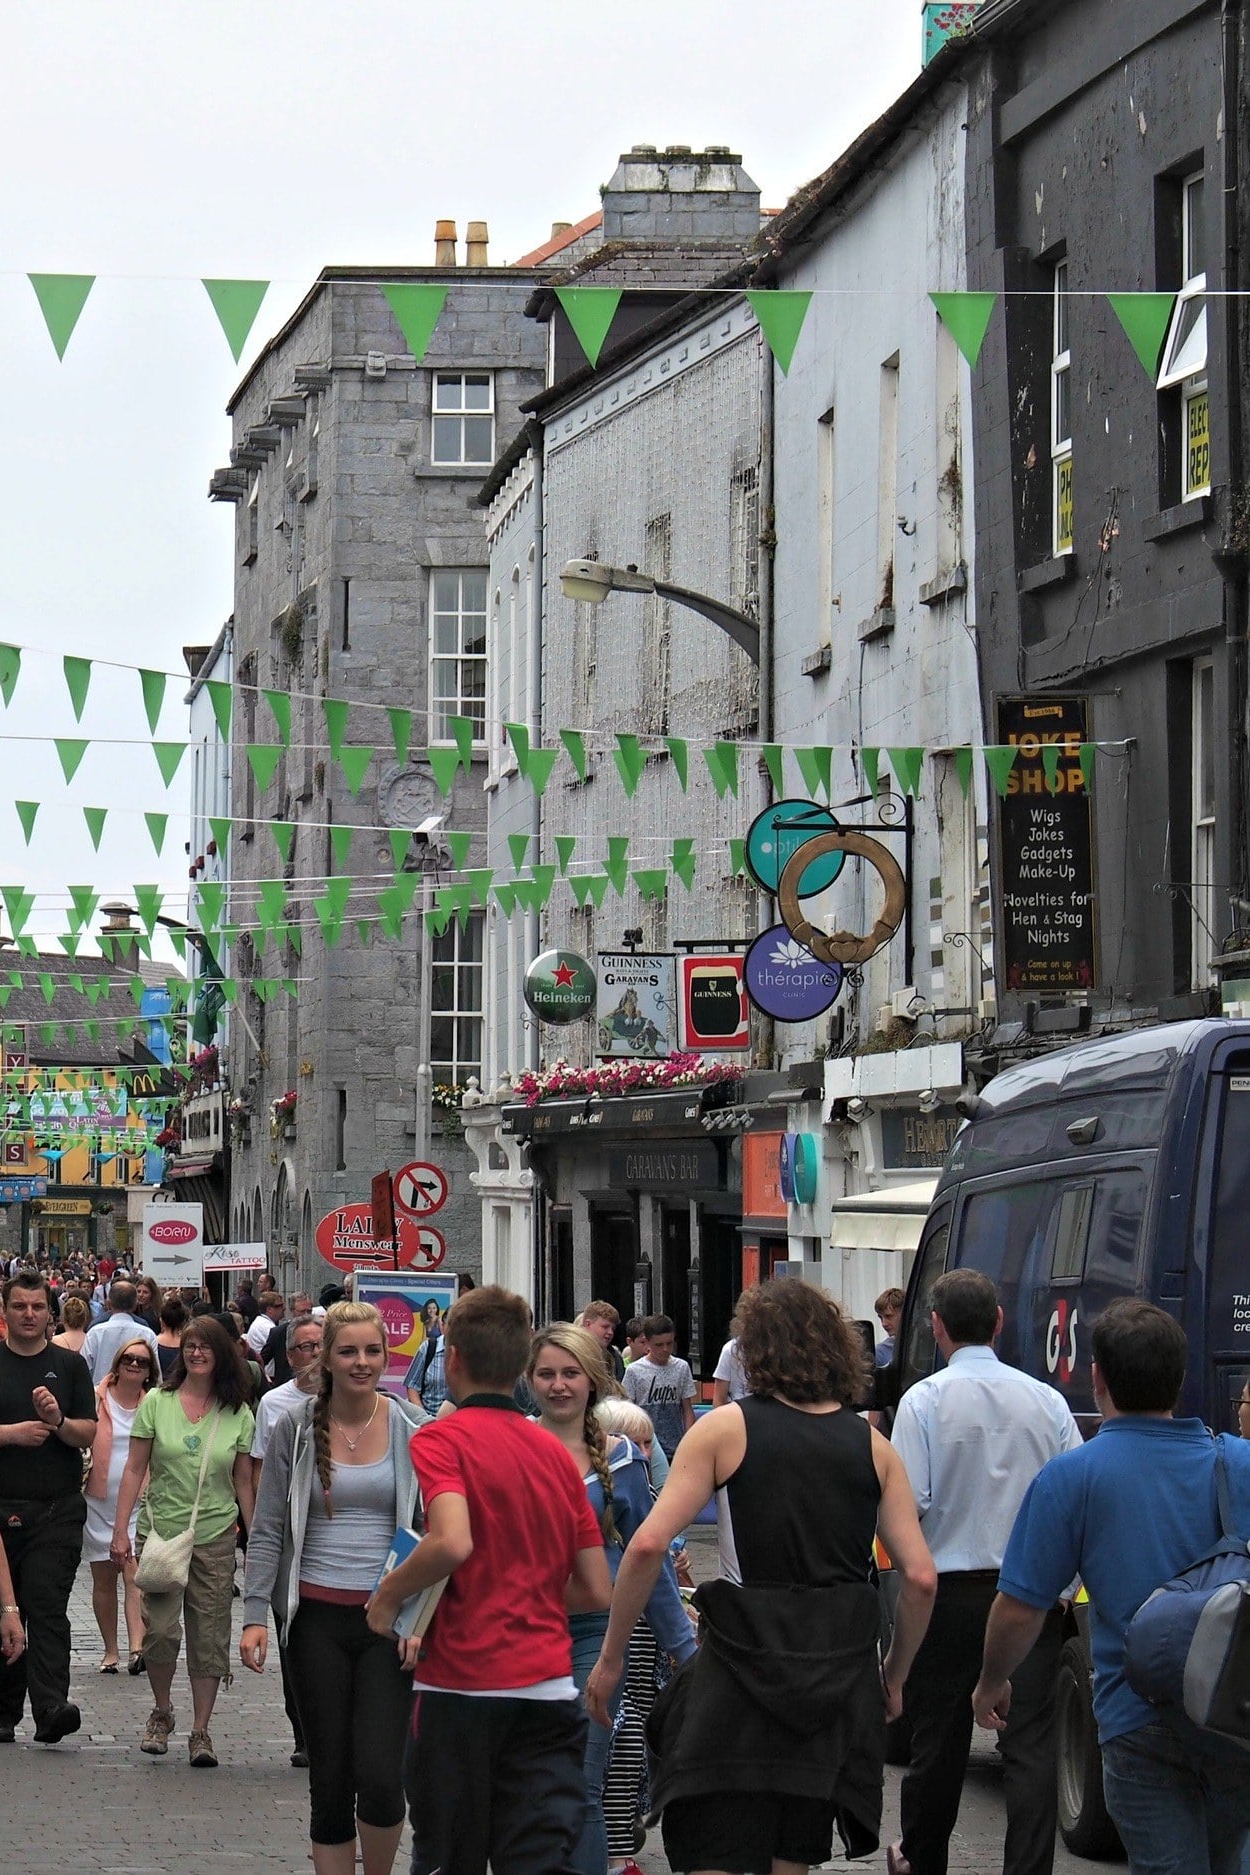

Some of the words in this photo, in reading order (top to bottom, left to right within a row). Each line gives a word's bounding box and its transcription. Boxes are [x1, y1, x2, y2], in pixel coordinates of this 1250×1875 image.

[1191, 403, 1209, 439] ELEC
[1190, 442, 1210, 488] REP
[1006, 769, 1085, 795] SHOP
[1030, 809, 1061, 827] Wigs
[1029, 827, 1064, 842] Jokes
[1021, 846, 1073, 863] Gadgets
[1019, 864, 1076, 881] Make-Up
[1004, 892, 1064, 907] Novelties
[1070, 891, 1088, 906] for
[1012, 911, 1037, 926] Hen
[1043, 916, 1050, 925] &
[1054, 911, 1083, 928] Stag
[1027, 929, 1070, 947] Nights
[601, 956, 662, 969] GUINNESS
[1027, 960, 1048, 969] Come
[1062, 961, 1072, 970] up
[605, 973, 659, 986] GARAVANS
[1021, 973, 1027, 981] &
[1030, 972, 1048, 981] have
[533, 991, 591, 1003] Heineken
[680, 1154, 699, 1179] BAR
[154, 1226, 191, 1237] BORN
[333, 1235, 403, 1251] Menswear
[231, 1256, 266, 1264] TATTOO
[382, 1323, 410, 1334] ALE
